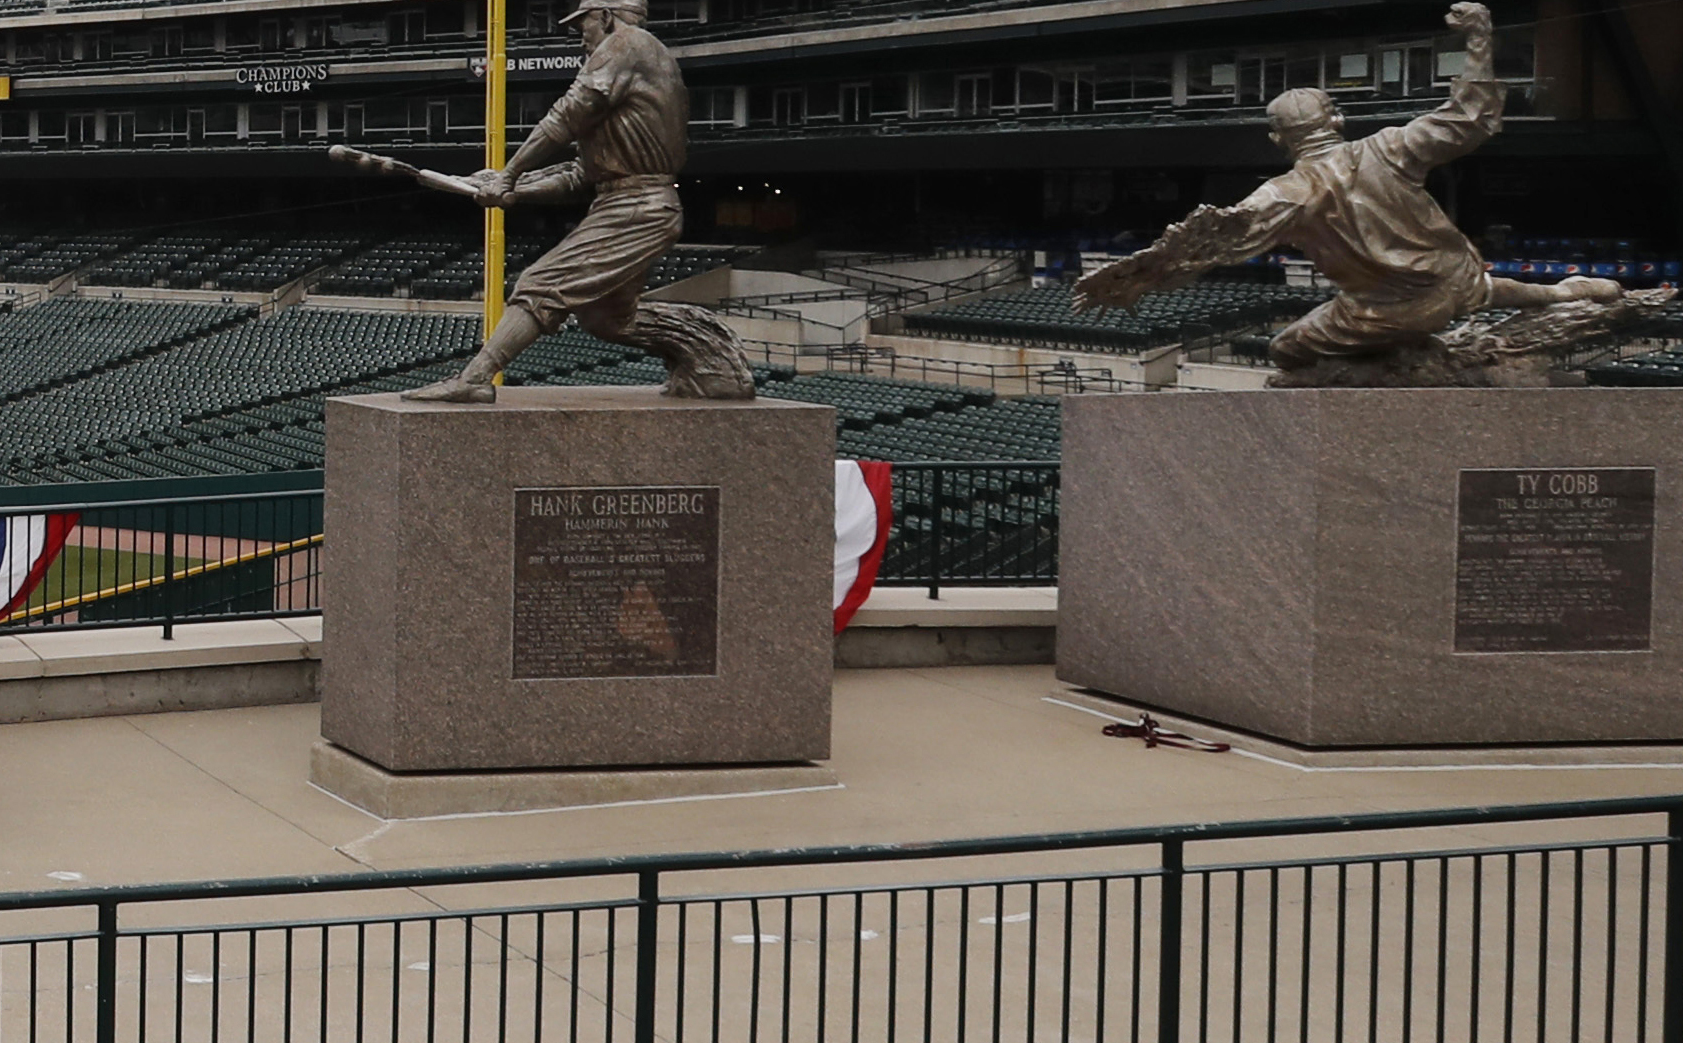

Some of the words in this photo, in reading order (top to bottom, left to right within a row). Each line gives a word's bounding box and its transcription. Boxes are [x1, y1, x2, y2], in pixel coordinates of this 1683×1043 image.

[518, 56, 583, 71] NETWORK
[236, 64, 327, 84] CHAMPIONS
[264, 81, 301, 93] CLUB
[1517, 474, 1541, 495] TY
[1548, 473, 1599, 495] COBB
[530, 495, 584, 516] HANK
[592, 493, 705, 515] GREENBERG
[1496, 498, 1518, 509] THE
[1523, 498, 1575, 509] GEORGIA
[1580, 497, 1618, 508] PEACH
[636, 517, 670, 529] HANK
